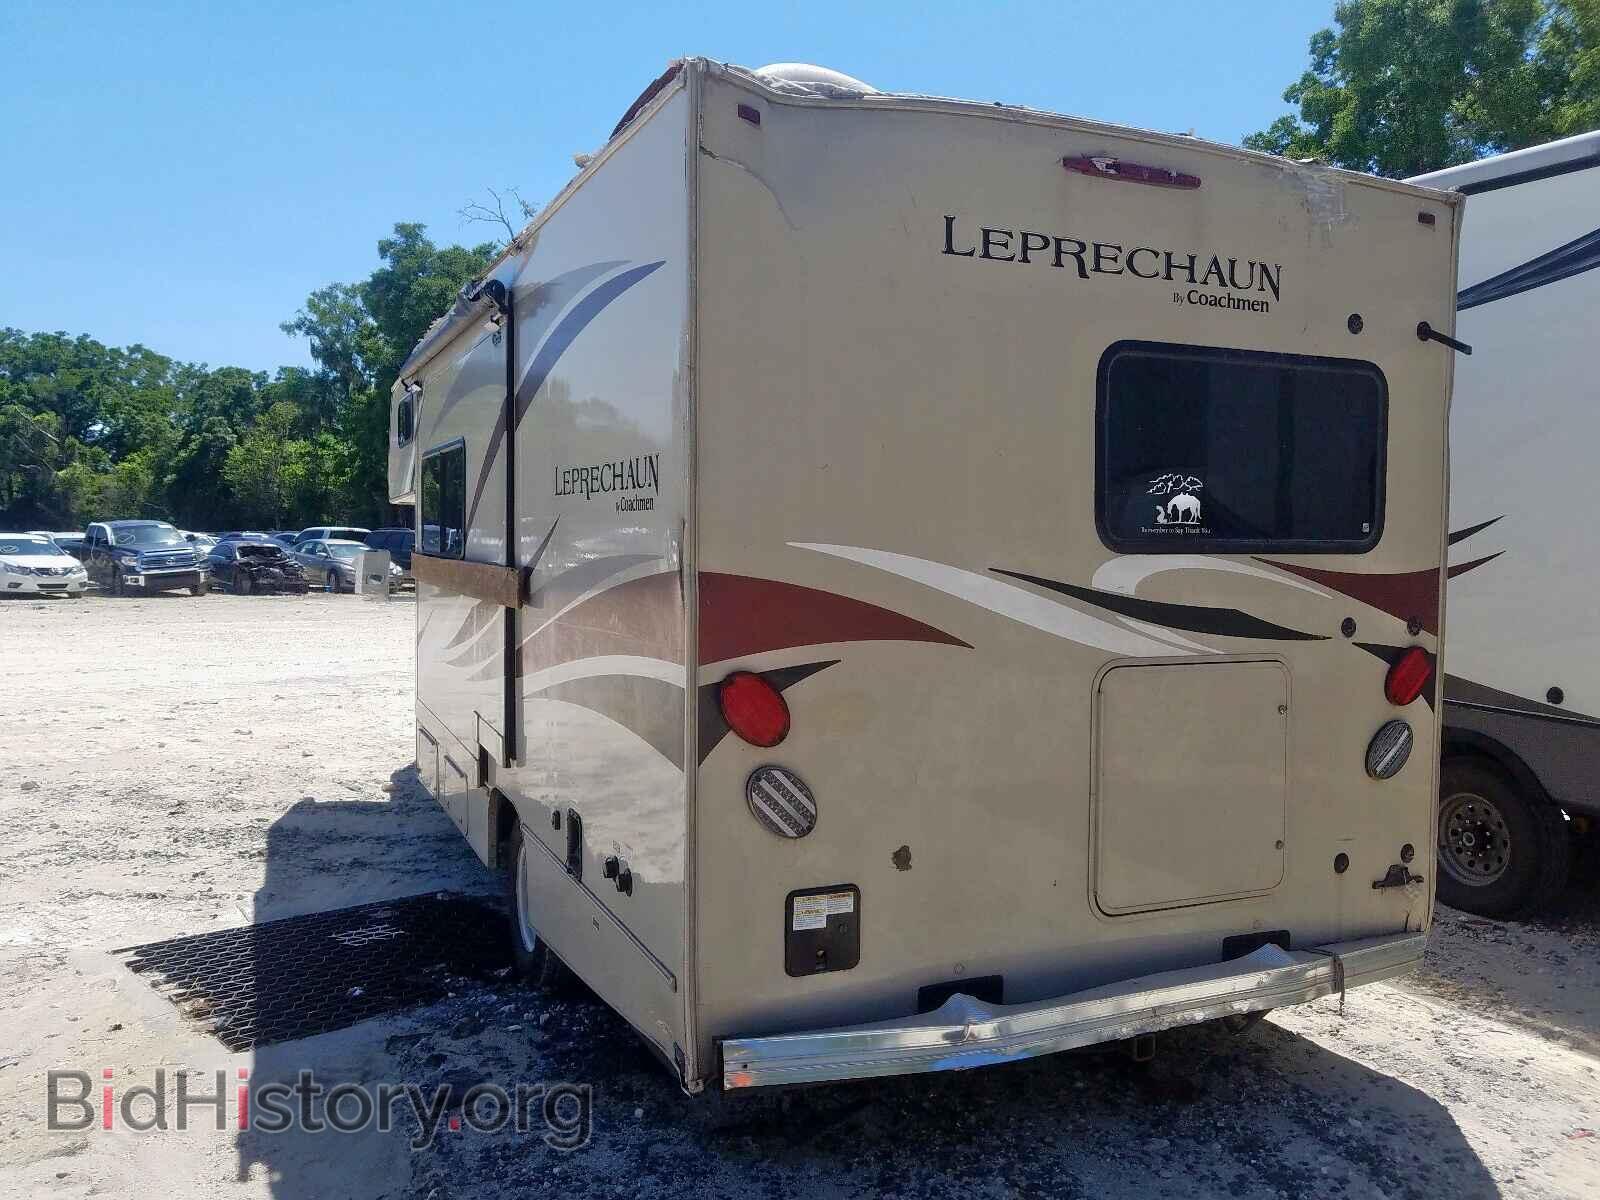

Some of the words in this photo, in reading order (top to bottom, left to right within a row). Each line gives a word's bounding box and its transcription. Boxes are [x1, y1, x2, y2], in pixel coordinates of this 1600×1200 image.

[942, 214, 1282, 303] LEPRECHAUN
[1173, 291, 1185, 306] By
[1187, 289, 1270, 314] Coachmen
[555, 453, 659, 501] LEPRECHAUN
[621, 495, 654, 512] Coachmen
